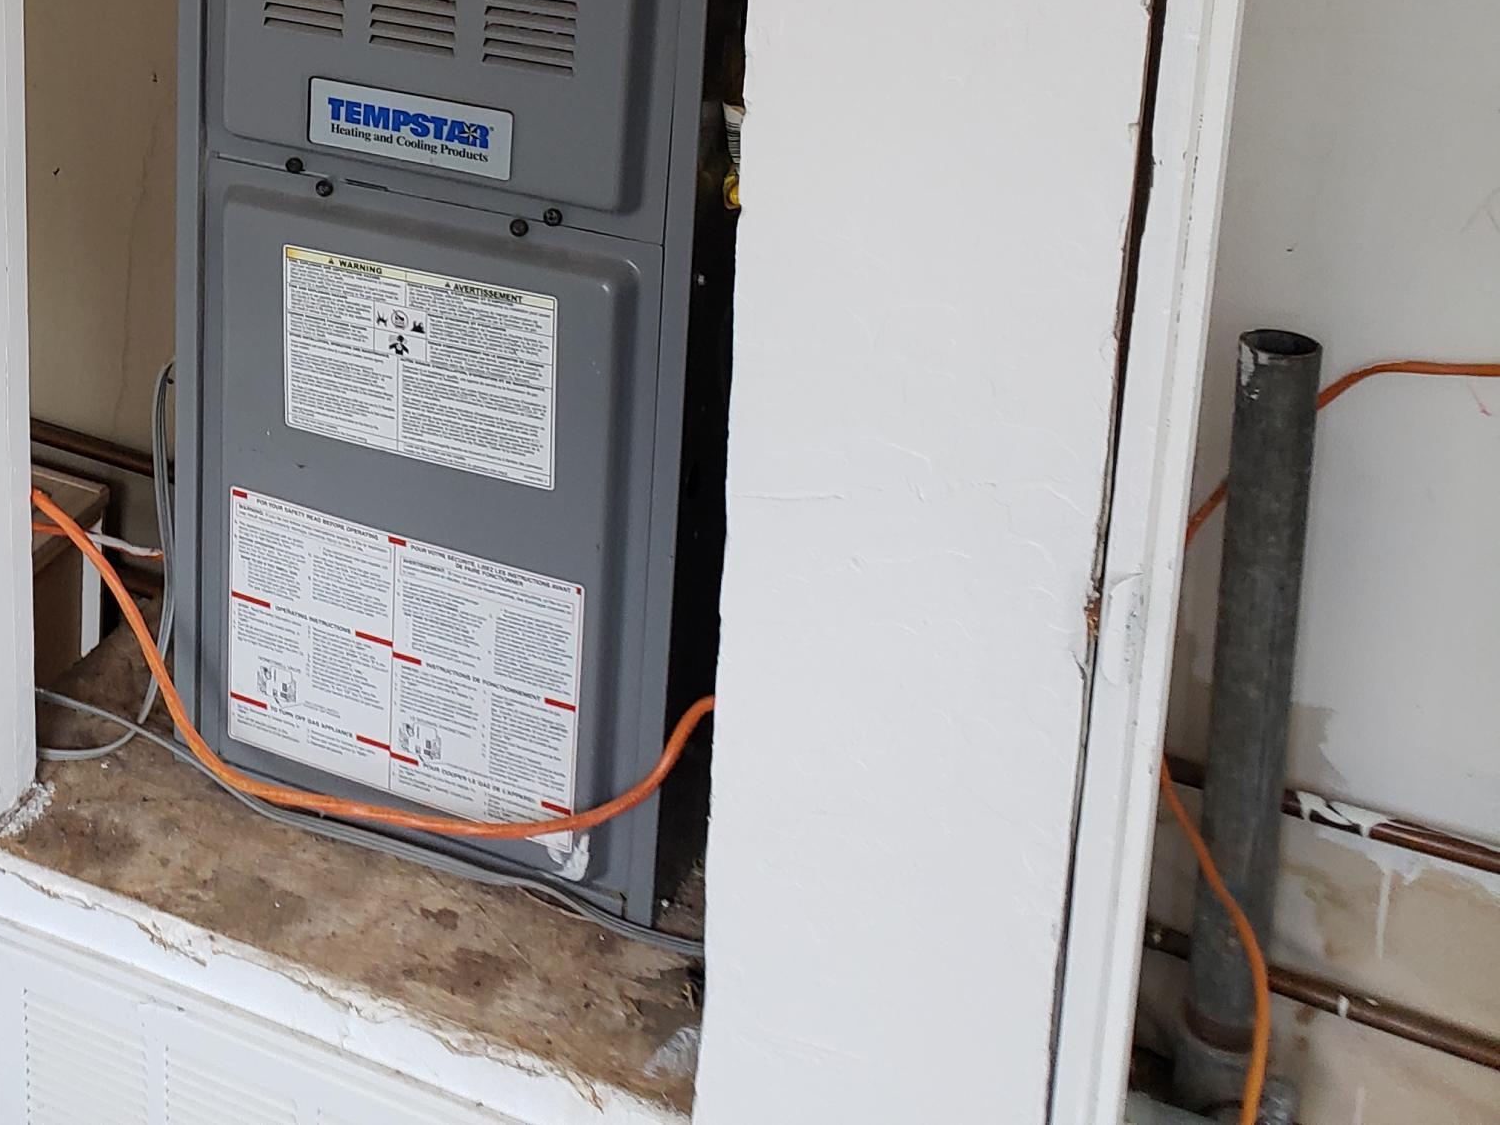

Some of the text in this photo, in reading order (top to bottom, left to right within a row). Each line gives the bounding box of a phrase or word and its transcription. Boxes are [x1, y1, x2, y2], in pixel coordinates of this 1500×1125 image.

[328, 97, 490, 149] TEMPSTAR
[331, 123, 489, 163] Heating and Cooling Products
[339, 259, 383, 275] WARNING
[453, 283, 524, 303] AVERTISSEMENT
